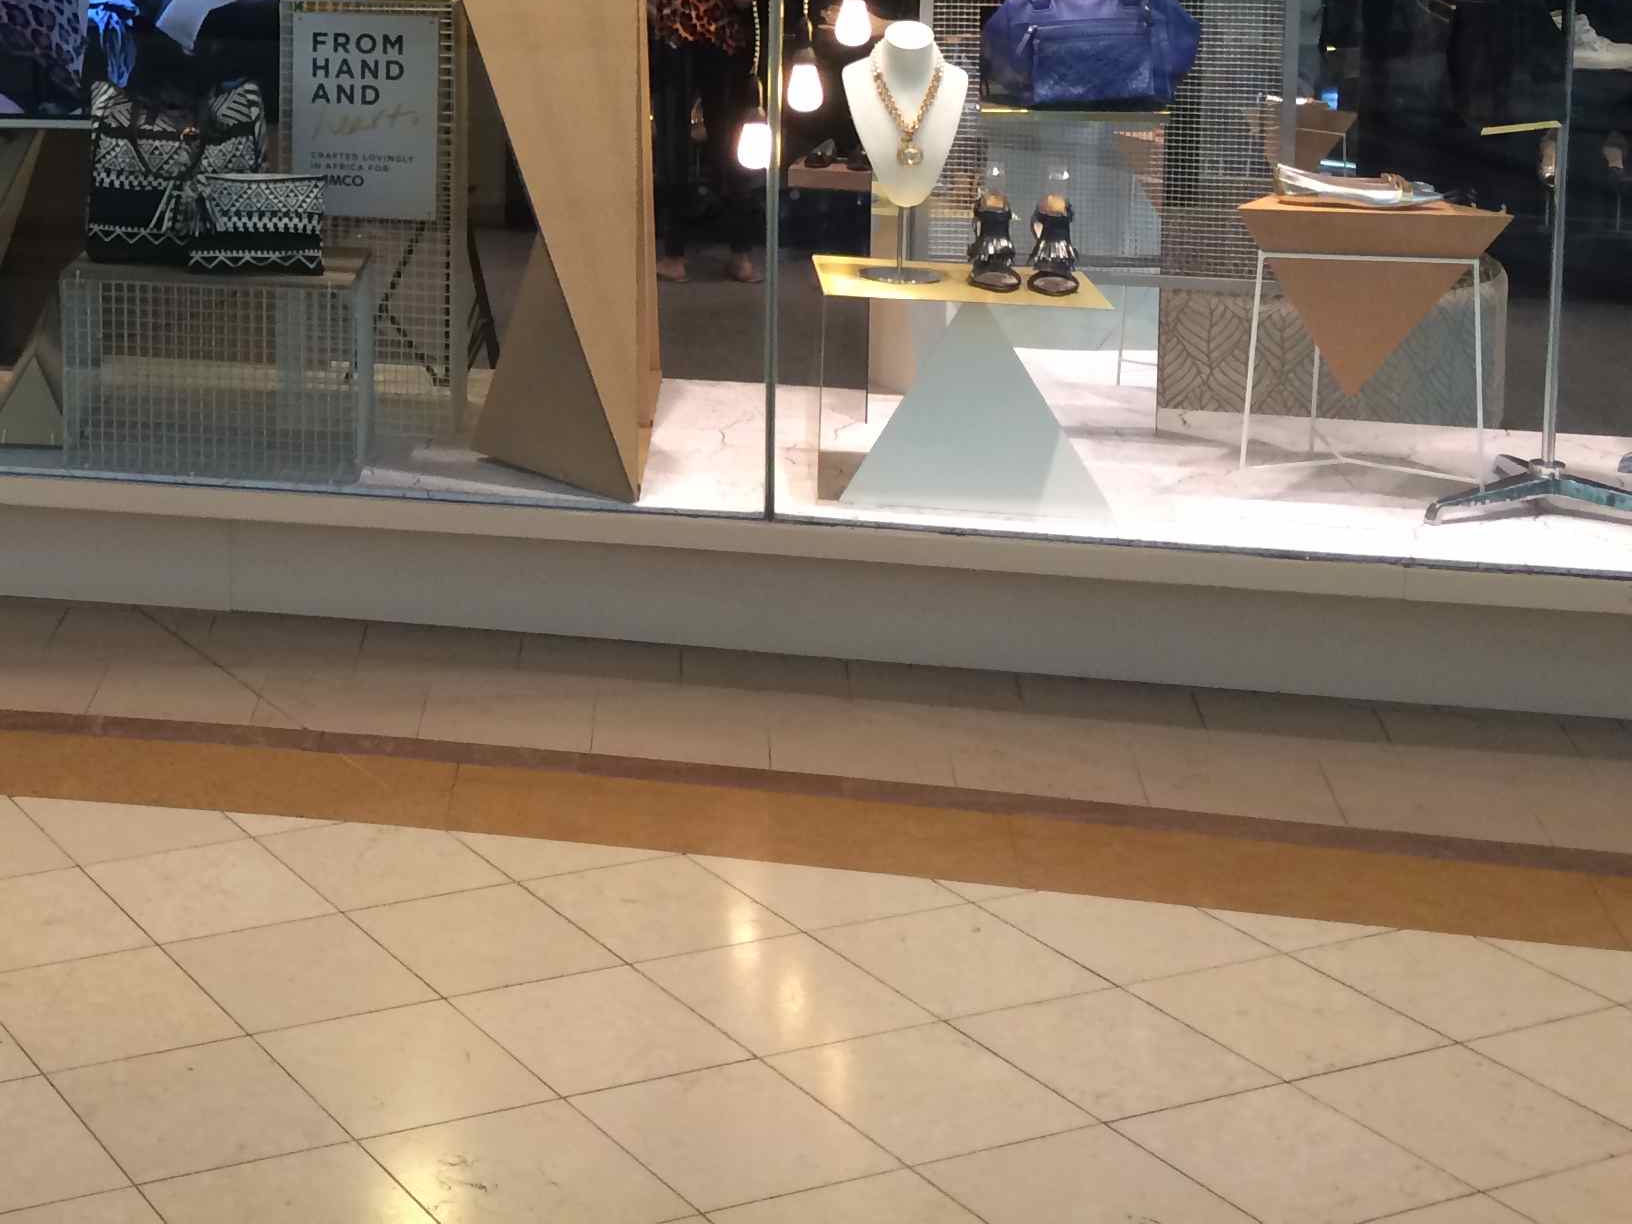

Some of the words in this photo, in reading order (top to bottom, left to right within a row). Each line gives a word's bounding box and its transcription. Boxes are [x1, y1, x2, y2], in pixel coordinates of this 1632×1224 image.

[312, 32, 403, 55] FROM
[312, 58, 404, 80] HAND
[312, 83, 380, 105] AND
